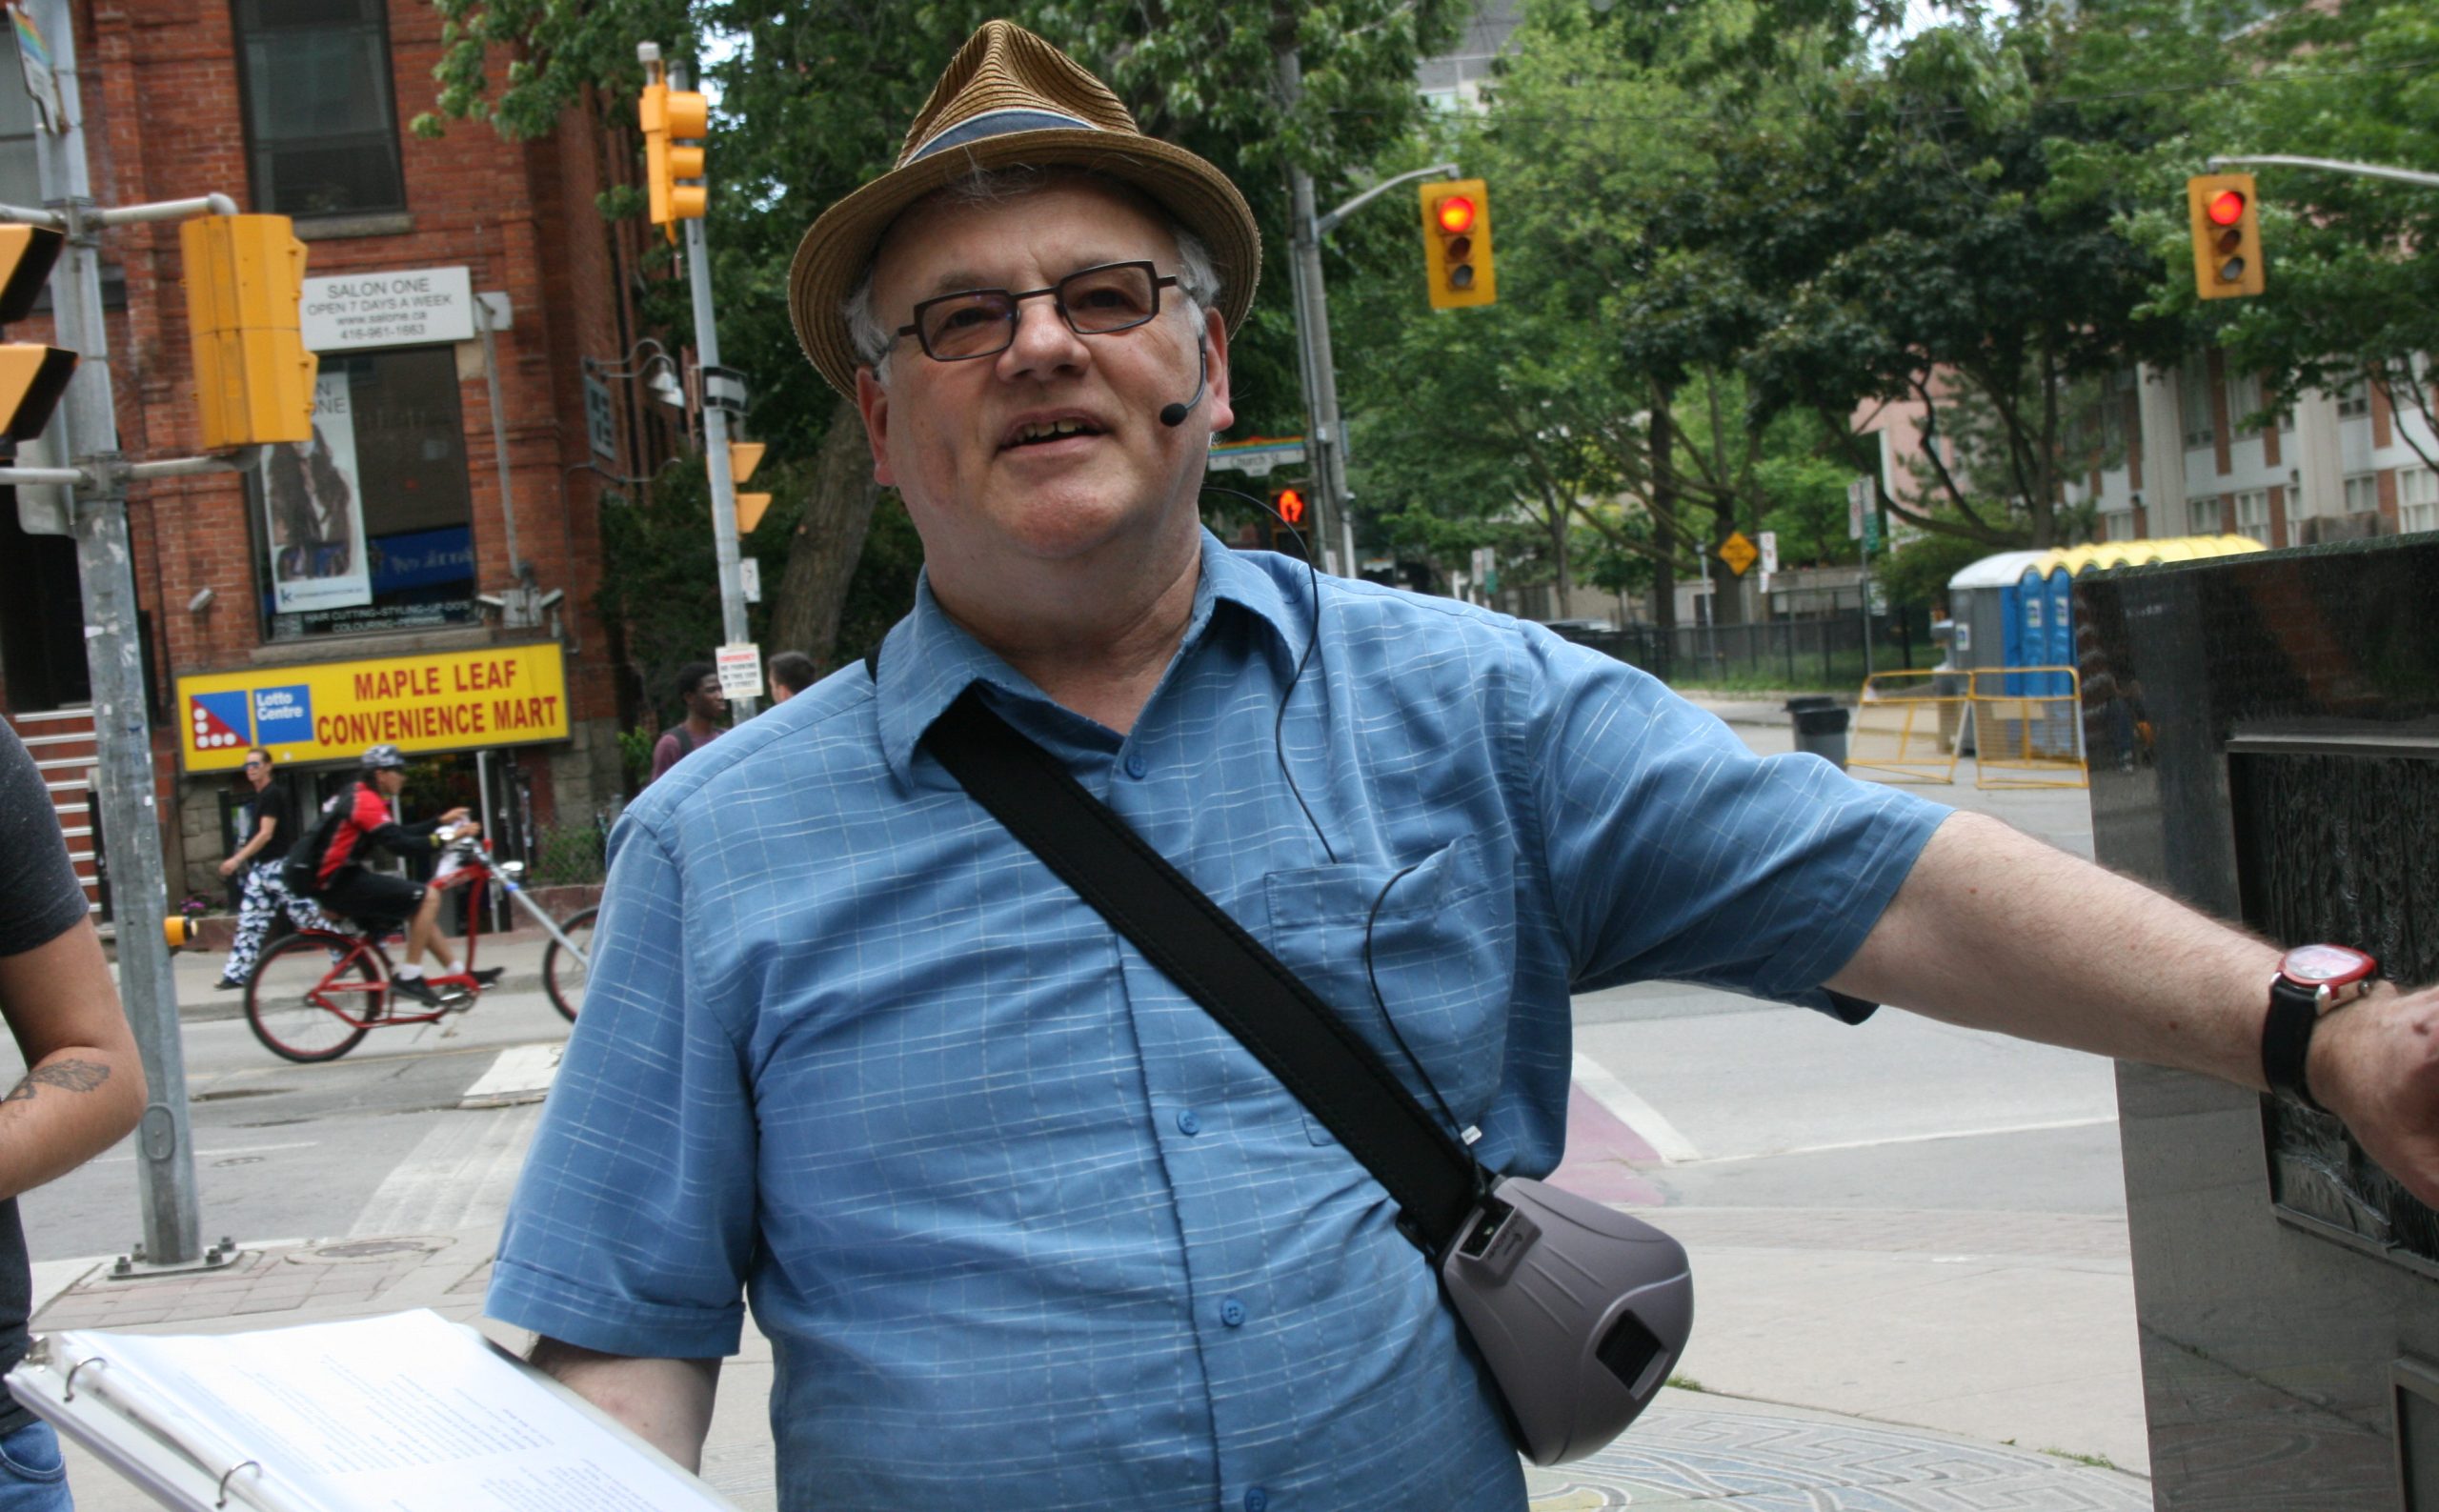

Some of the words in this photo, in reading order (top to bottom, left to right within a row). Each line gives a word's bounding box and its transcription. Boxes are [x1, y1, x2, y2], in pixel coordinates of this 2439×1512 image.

[328, 282, 387, 299] SALON
[392, 278, 431, 294] ONE
[307, 303, 346, 316] OPEN
[350, 301, 357, 312] 7
[360, 297, 397, 312] DAYS
[399, 297, 410, 309] A
[412, 294, 453, 308] WEEK
[354, 667, 441, 702] MAPLE
[454, 659, 517, 693] LEAF
[256, 692, 293, 708] Lotto
[257, 704, 304, 721] Centre
[316, 702, 486, 747] CONVENIENCE
[494, 696, 558, 732] MART
